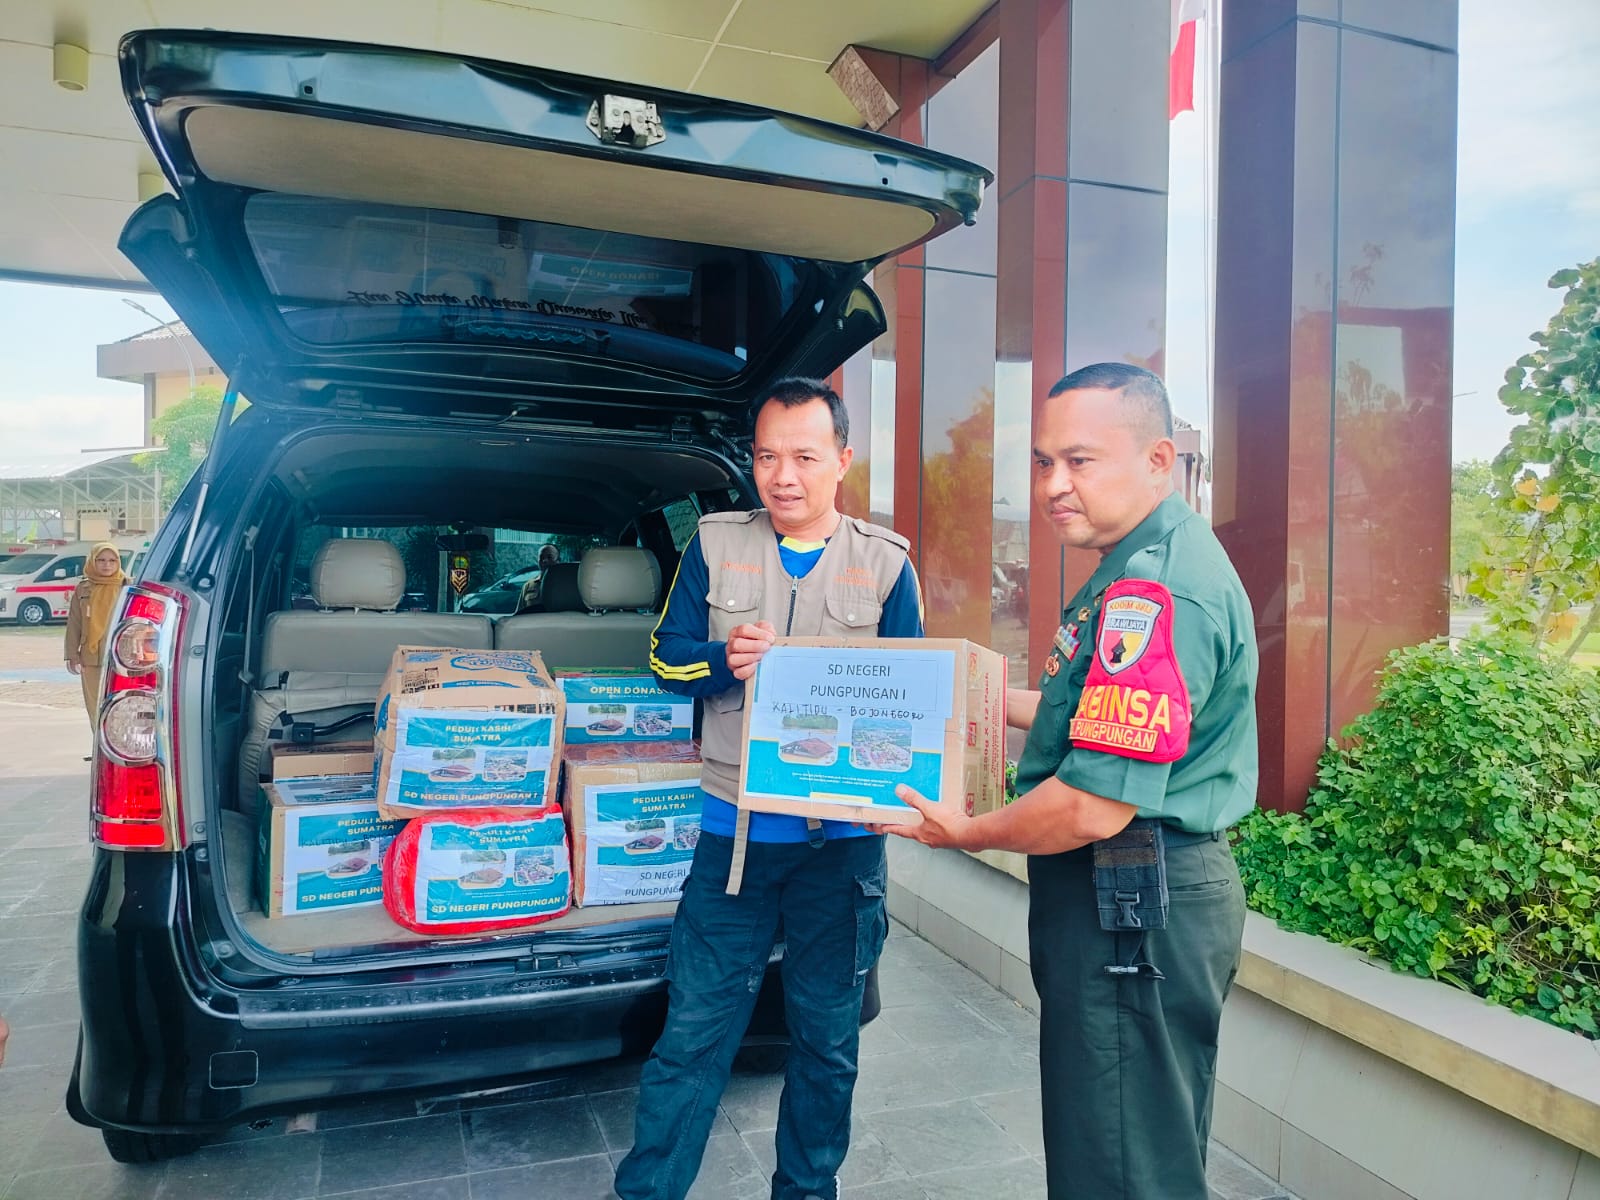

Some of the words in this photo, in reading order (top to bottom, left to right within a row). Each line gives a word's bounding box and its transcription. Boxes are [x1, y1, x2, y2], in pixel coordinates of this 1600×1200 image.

[827, 664, 843, 676] SD
[846, 664, 890, 677] NEGERI
[590, 686, 621, 694] OPEN
[810, 685, 898, 700] PUNGPUNGAN
[1075, 685, 1171, 734] ABINSA
[453, 734, 501, 743] SUMATRA
[1075, 721, 1153, 749] PUNGPUNGAN
[404, 790, 418, 798] SD
[420, 792, 459, 801] NEGERI
[461, 792, 532, 801] PUNGPUNGAN
[632, 795, 665, 804] PEDULI
[667, 793, 695, 802] KASIH
[641, 803, 686, 813] SUMATRA
[338, 818, 373, 827] PEDULI
[347, 824, 394, 836] SUMATRA
[640, 871, 652, 881] SD
[302, 894, 316, 902] SD
[319, 890, 357, 900] NEGERI
[431, 905, 446, 913] SD
[449, 903, 489, 913] NEGERI
[492, 897, 560, 910] PUNGPUNGAN
